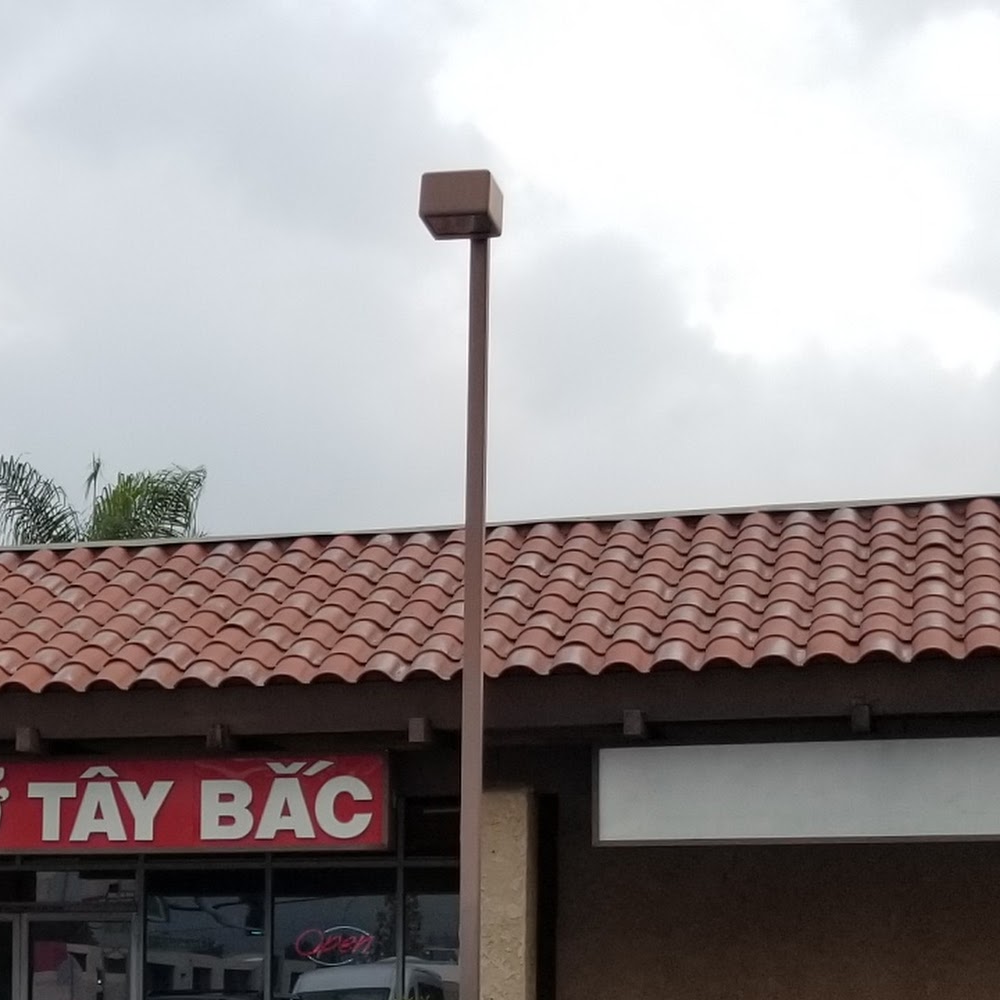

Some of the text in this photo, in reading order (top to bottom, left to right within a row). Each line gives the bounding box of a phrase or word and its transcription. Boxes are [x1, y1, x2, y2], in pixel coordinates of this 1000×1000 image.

[27, 766, 174, 842] TÂY
[200, 760, 373, 840] BẮC
[296, 929, 374, 958] Open
